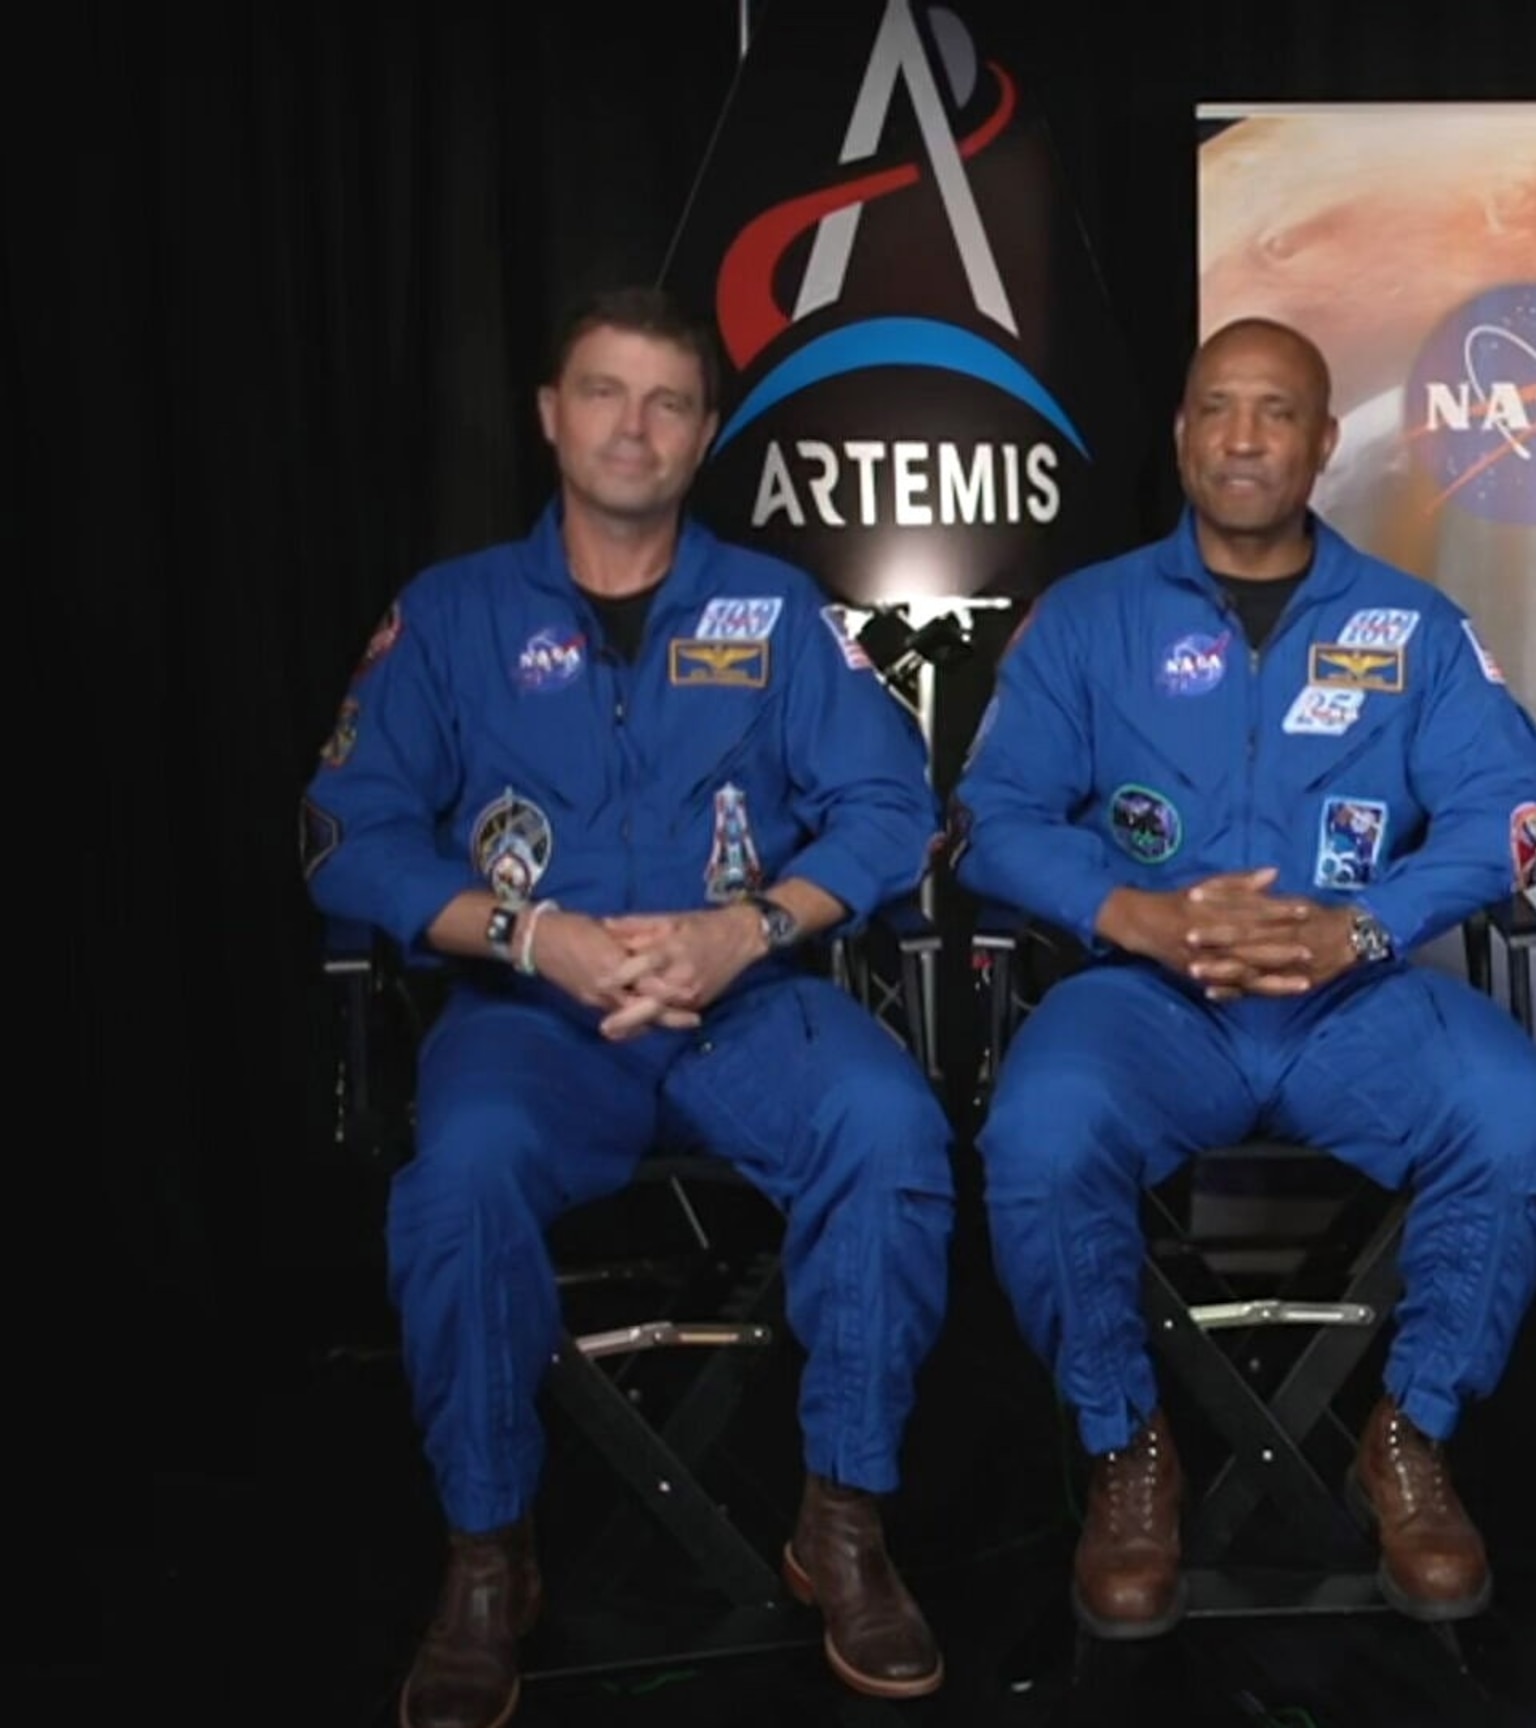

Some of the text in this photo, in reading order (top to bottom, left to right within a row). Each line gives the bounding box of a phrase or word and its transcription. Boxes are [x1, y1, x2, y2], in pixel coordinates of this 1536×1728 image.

[751, 440, 1061, 527] ARTEMIS
[519, 646, 580, 672] NASA
[1165, 653, 1222, 675] NASA
